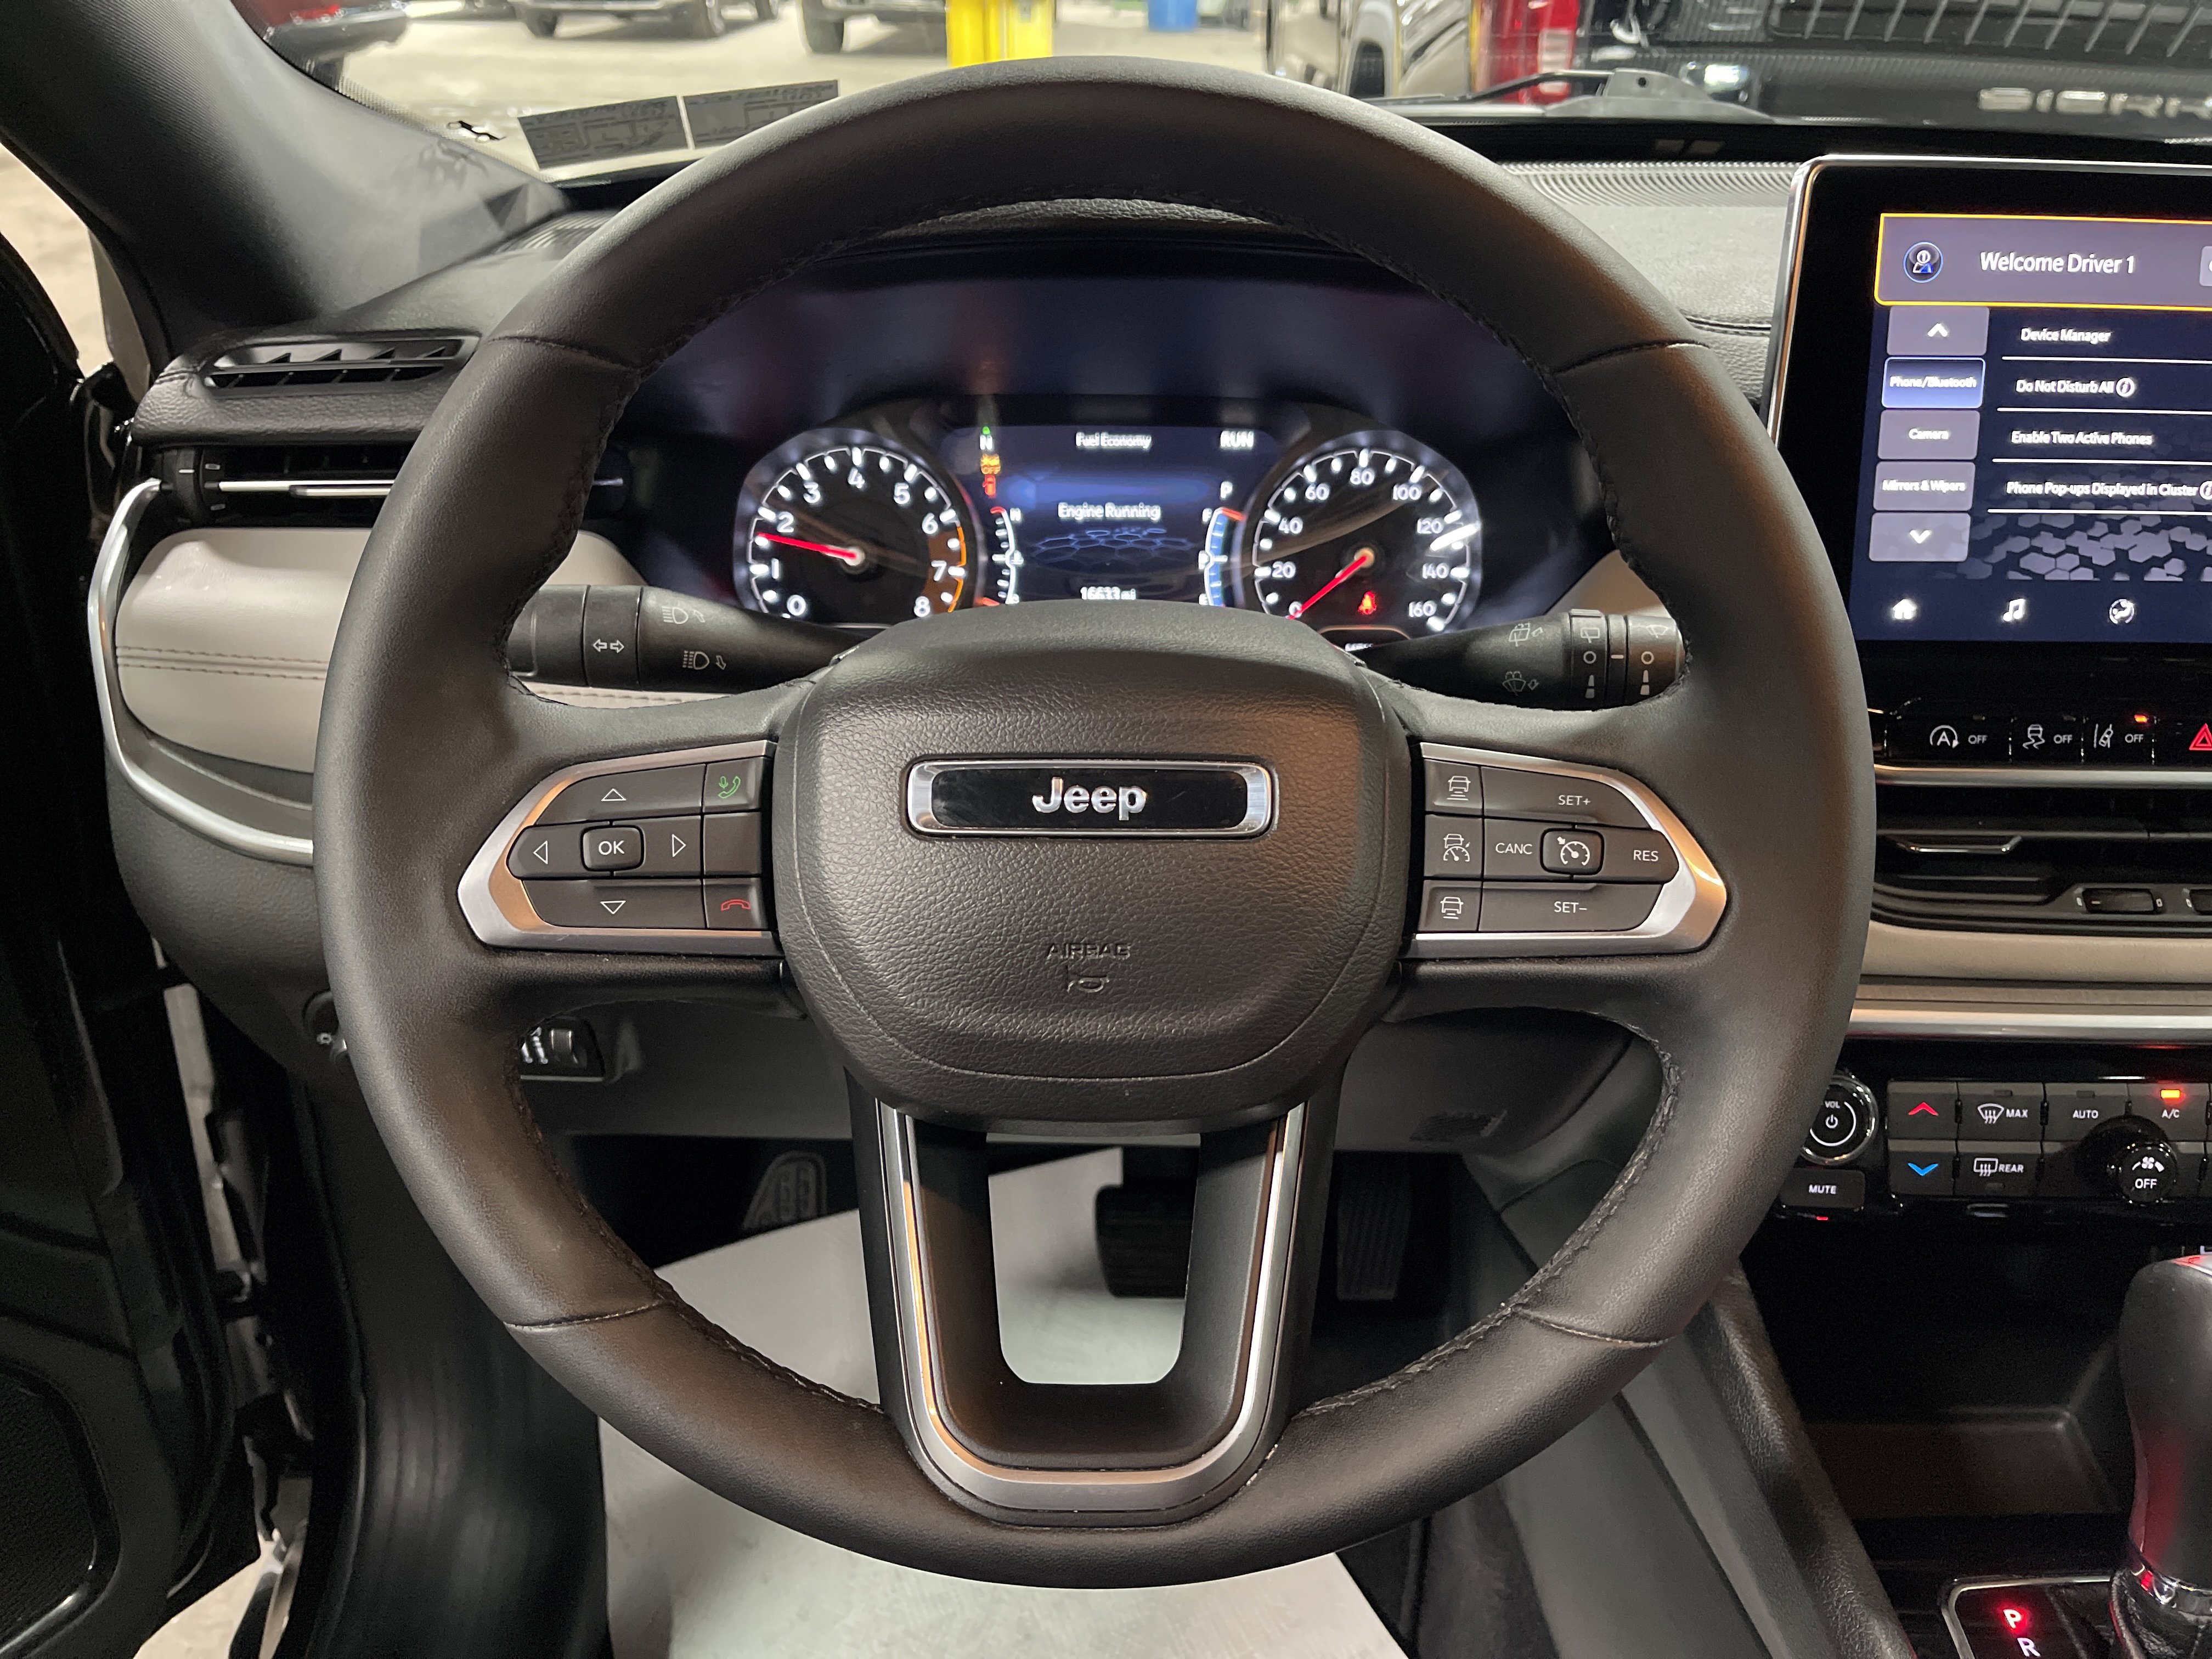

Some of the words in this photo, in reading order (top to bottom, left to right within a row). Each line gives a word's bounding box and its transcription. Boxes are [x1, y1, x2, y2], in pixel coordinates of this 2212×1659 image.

[1980, 252, 2063, 272] Welcome
[2068, 253, 2122, 273] Driver
[2127, 256, 2135, 274] 1
[2021, 328, 2058, 341] Device
[2060, 330, 2111, 345] Manager
[1890, 376, 1977, 388] Phone/Bluetooth
[2016, 380, 2033, 393] Do
[2034, 380, 2057, 393] Not
[2057, 381, 2098, 394] Disturb
[2099, 381, 2114, 393] All
[1076, 432, 1100, 447] Fuel
[1101, 432, 1152, 449] Economy
[1220, 431, 1254, 448] RUN
[1909, 428, 1949, 439] Camera
[2012, 431, 2050, 443] Enable
[2051, 431, 2074, 444] Two
[2075, 432, 2110, 444] Active
[2111, 432, 2152, 445] Phones
[980, 435, 993, 450] N
[848, 467, 866, 489] 4
[1350, 469, 1375, 486] 80
[803, 482, 821, 504] 3
[894, 482, 911, 505] 5
[1221, 481, 1233, 499] P
[1305, 485, 1330, 501] 60
[1392, 486, 1422, 500] 100
[1883, 479, 1920, 491] Mirrors
[1921, 480, 1929, 492] &
[1931, 479, 1965, 493] Wipers
[2007, 482, 2042, 494] Phone
[2045, 482, 2091, 496] Pop-ups
[2092, 482, 2145, 497] Displayed
[2146, 483, 2157, 495] in
[2159, 484, 2198, 496] Cluster
[1058, 503, 1103, 520] Engine
[1104, 503, 1161, 521] Running
[777, 511, 795, 534] 2
[922, 512, 939, 535] 6
[1278, 518, 1304, 534] 40
[1416, 518, 1444, 534] 120
[771, 558, 780, 579] 1
[931, 561, 947, 582] 7
[1271, 562, 1296, 579] 20
[1421, 563, 1448, 579] 140
[787, 595, 806, 617] 0
[913, 596, 932, 618] 8
[1408, 602, 1436, 617] 160
[1968, 735, 1987, 744] OFF
[2053, 734, 2073, 744] OFF
[2125, 733, 2144, 743] OFF
[1032, 777, 1147, 821] Jeep
[1558, 794, 1591, 807] SET+
[598, 840, 624, 855] OK
[1495, 842, 1533, 855] CANC
[1633, 850, 1659, 862] RES
[1046, 941, 1131, 959] AIRBAG
[1825, 1101, 1841, 1109] VOL
[2006, 1109, 2029, 1119] MAX
[2072, 1110, 2099, 1119] AUTO
[2162, 1109, 2180, 1119] A/C
[1998, 1163, 2024, 1173] REAR
[1809, 1184, 1837, 1194] MUTE
[2135, 1178, 2158, 1189] OFF
[2003, 1609, 2022, 1629] P
[2017, 1637, 2041, 1657] R
